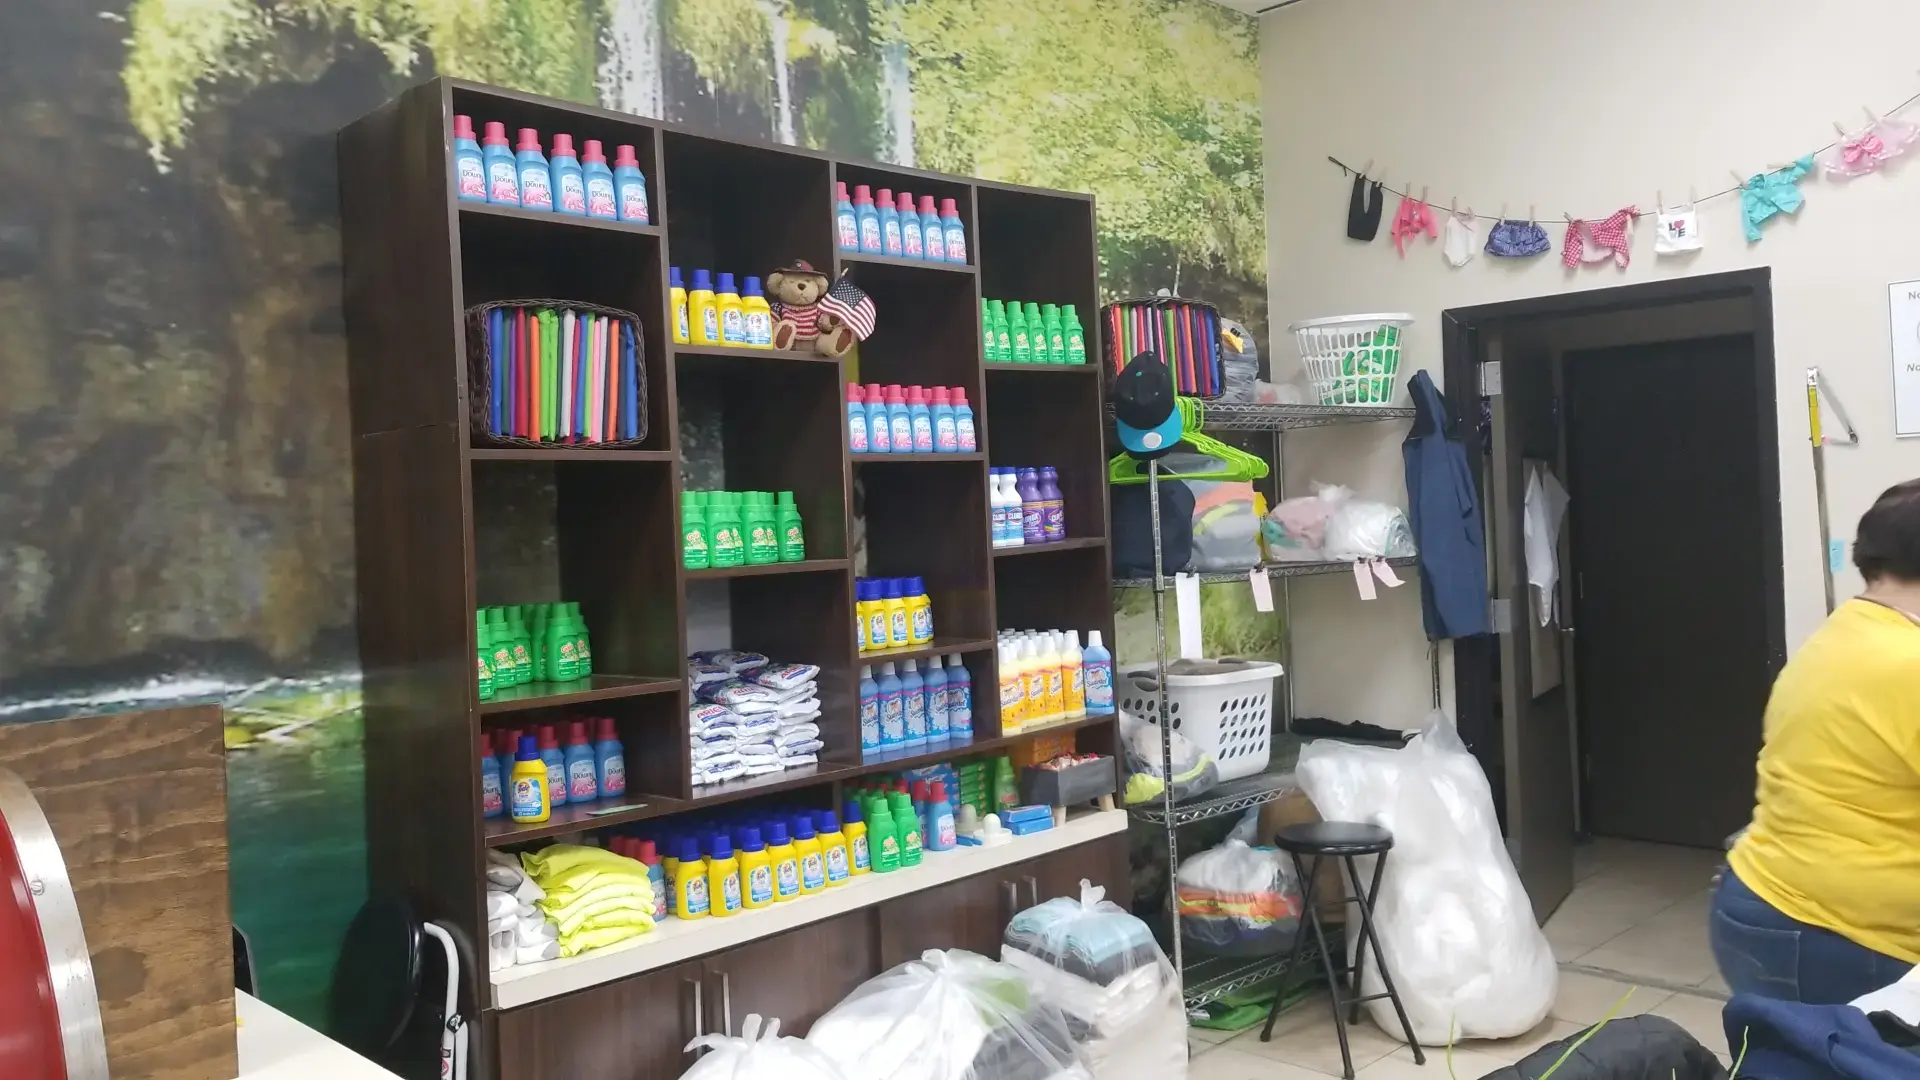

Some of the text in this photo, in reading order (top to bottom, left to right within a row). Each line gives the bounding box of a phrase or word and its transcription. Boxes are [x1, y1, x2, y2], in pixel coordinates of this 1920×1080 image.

[462, 169, 484, 183] Downy
[494, 175, 515, 186] Downy
[525, 180, 547, 192] Downy
[592, 190, 613, 202] Downy
[574, 771, 593, 780] Downy
